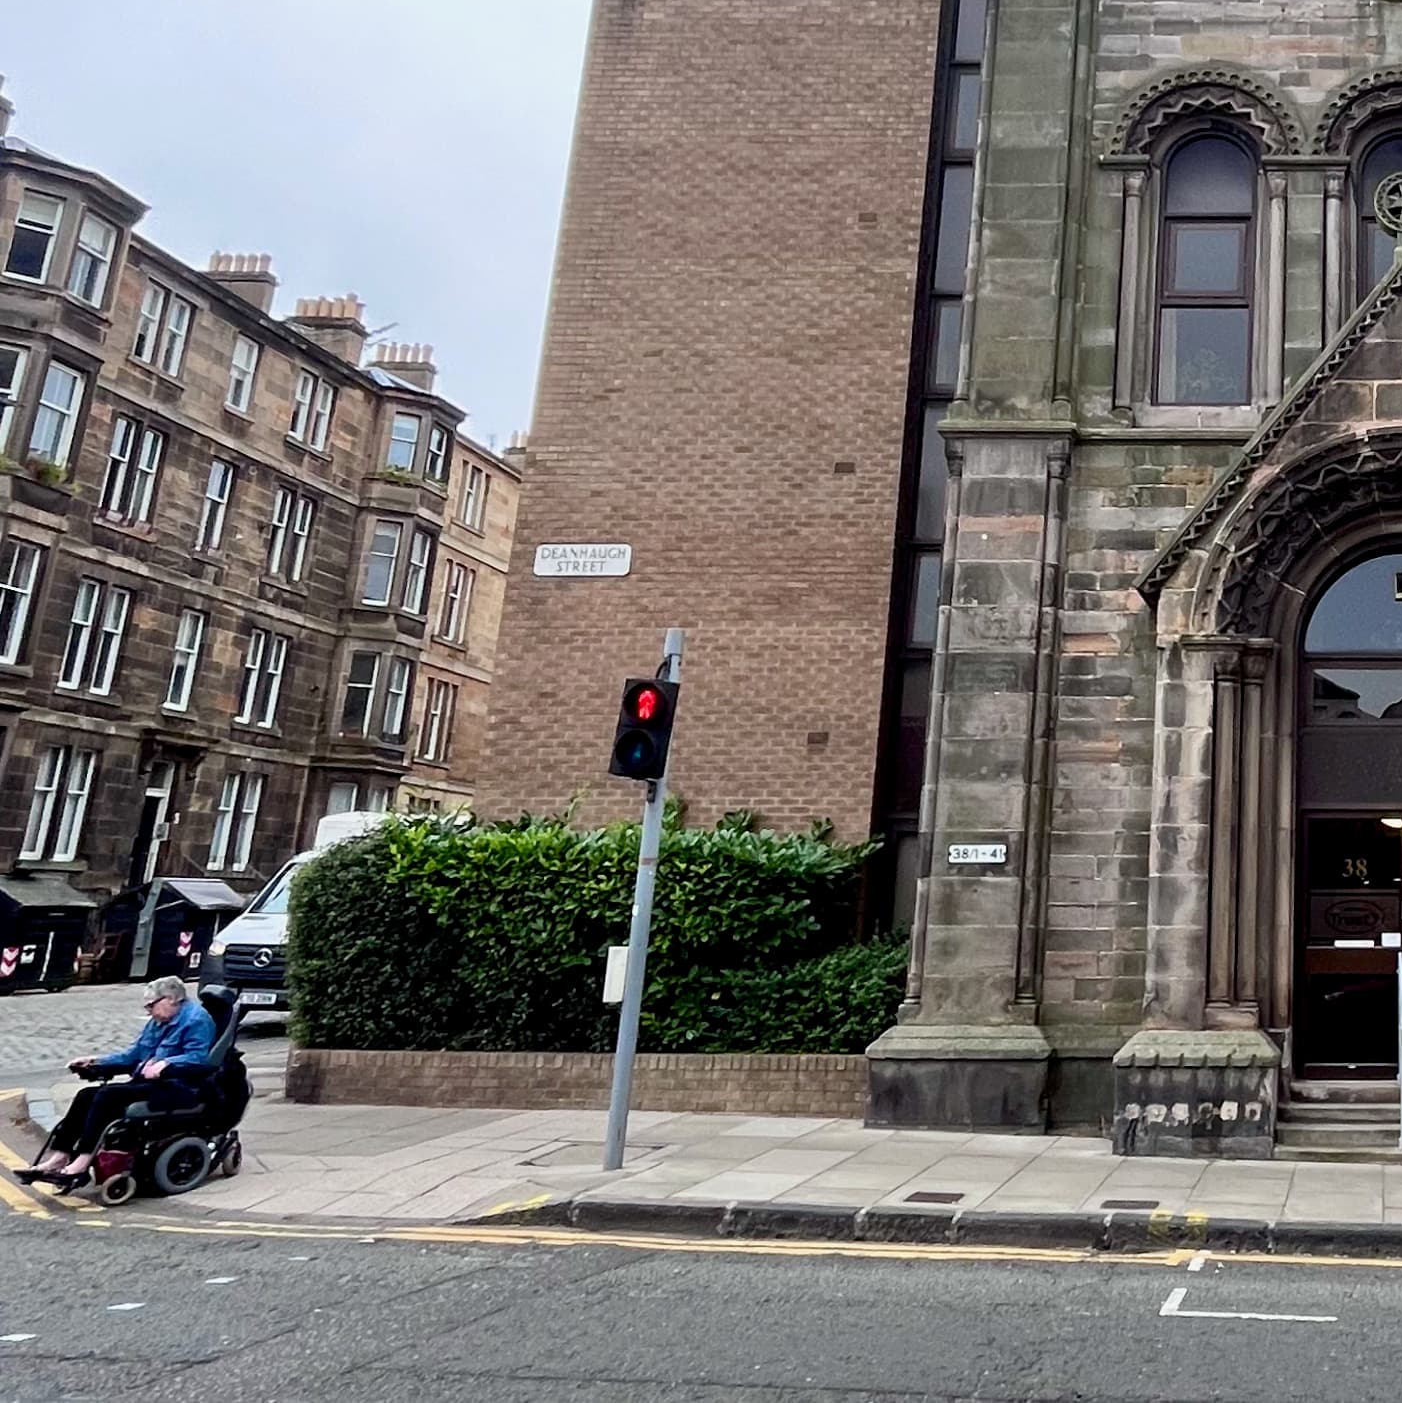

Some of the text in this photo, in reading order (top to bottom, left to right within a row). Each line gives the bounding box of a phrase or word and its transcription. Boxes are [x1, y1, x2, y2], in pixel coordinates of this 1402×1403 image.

[541, 547, 627, 559] DEANHAUGH
[555, 560, 607, 573] STREET
[1341, 858, 1368, 878] 38
